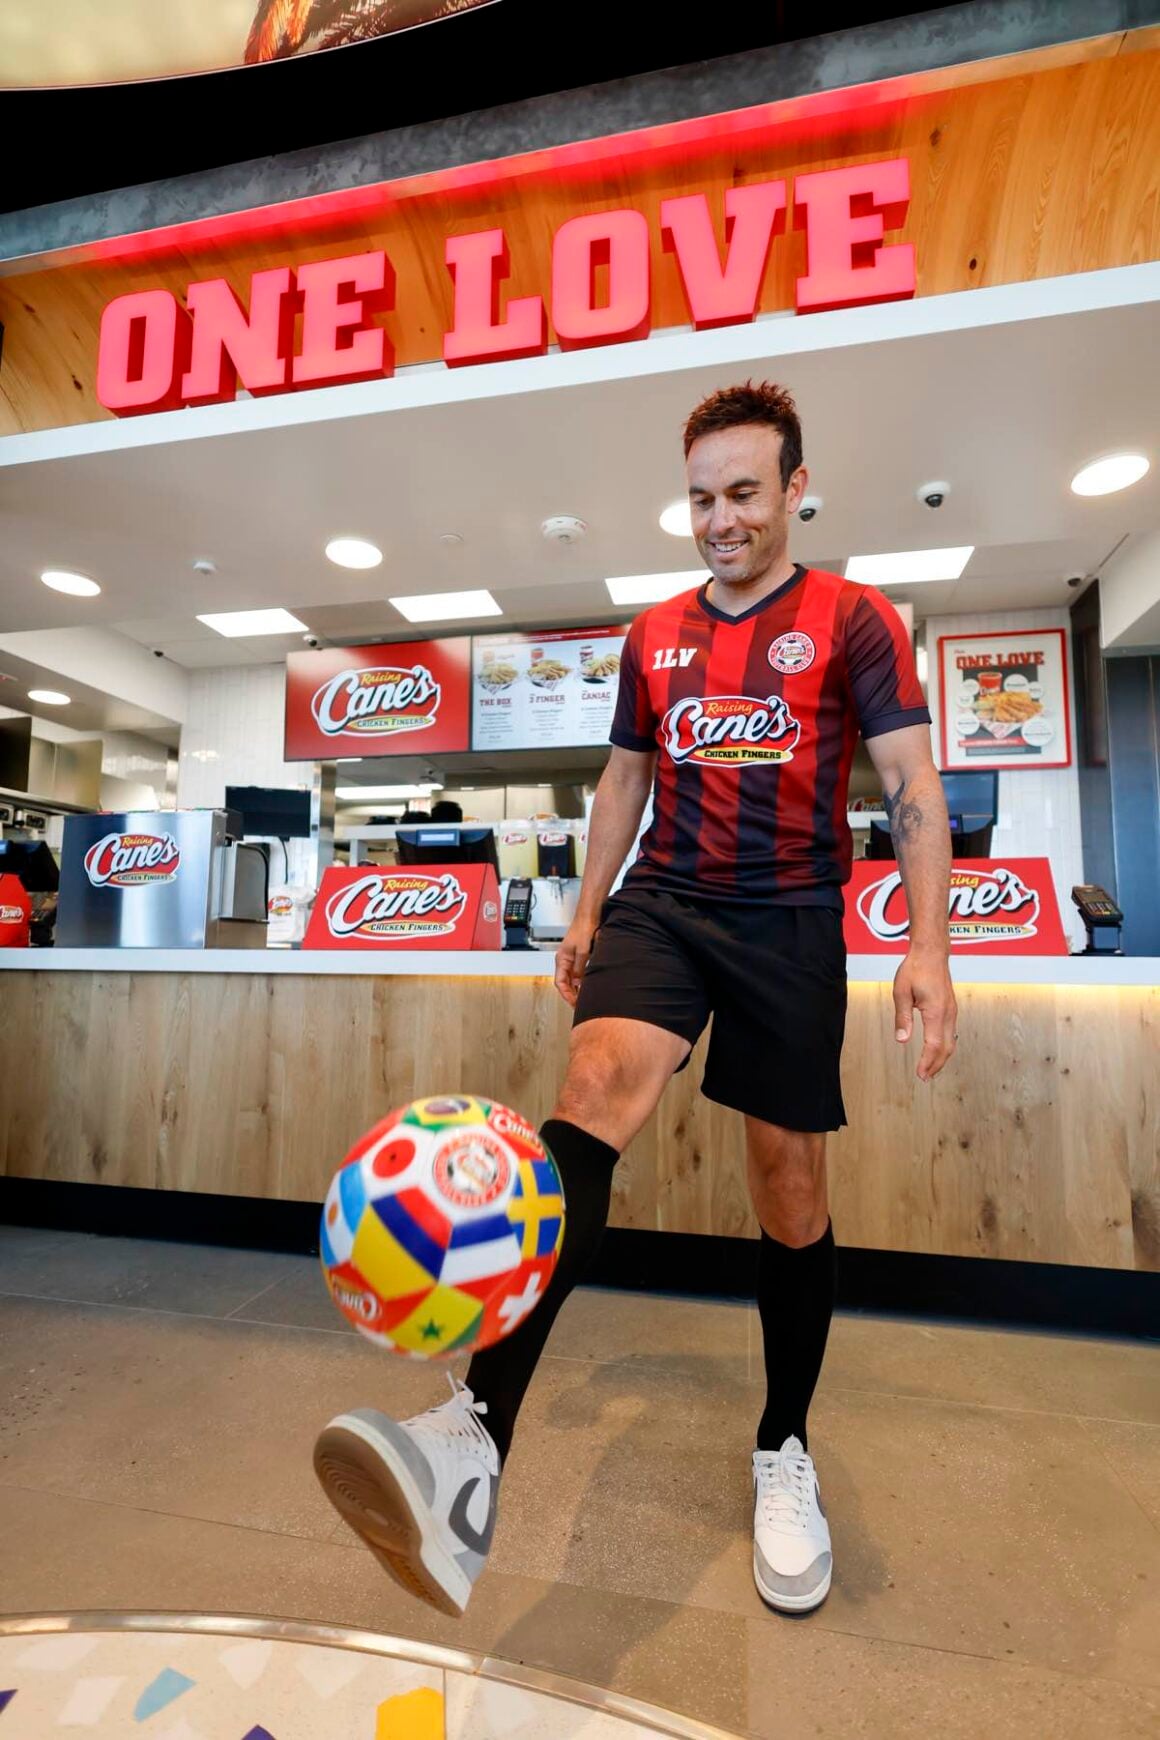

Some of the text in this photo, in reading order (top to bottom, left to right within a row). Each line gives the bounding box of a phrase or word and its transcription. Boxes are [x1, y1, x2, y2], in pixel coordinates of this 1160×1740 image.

[96, 158, 916, 417] ONE LOVE
[361, 671, 402, 686] Raising
[652, 648, 698, 670] 1LV
[956, 651, 1045, 670] ONE LOVE
[318, 665, 438, 733] Cane's
[705, 701, 753, 716] Raising
[668, 697, 798, 762] Cane's
[90, 832, 179, 885] Cane's
[384, 878, 428, 890] Raising
[331, 874, 466, 935] Cane's
[869, 872, 1035, 938] Cne's
